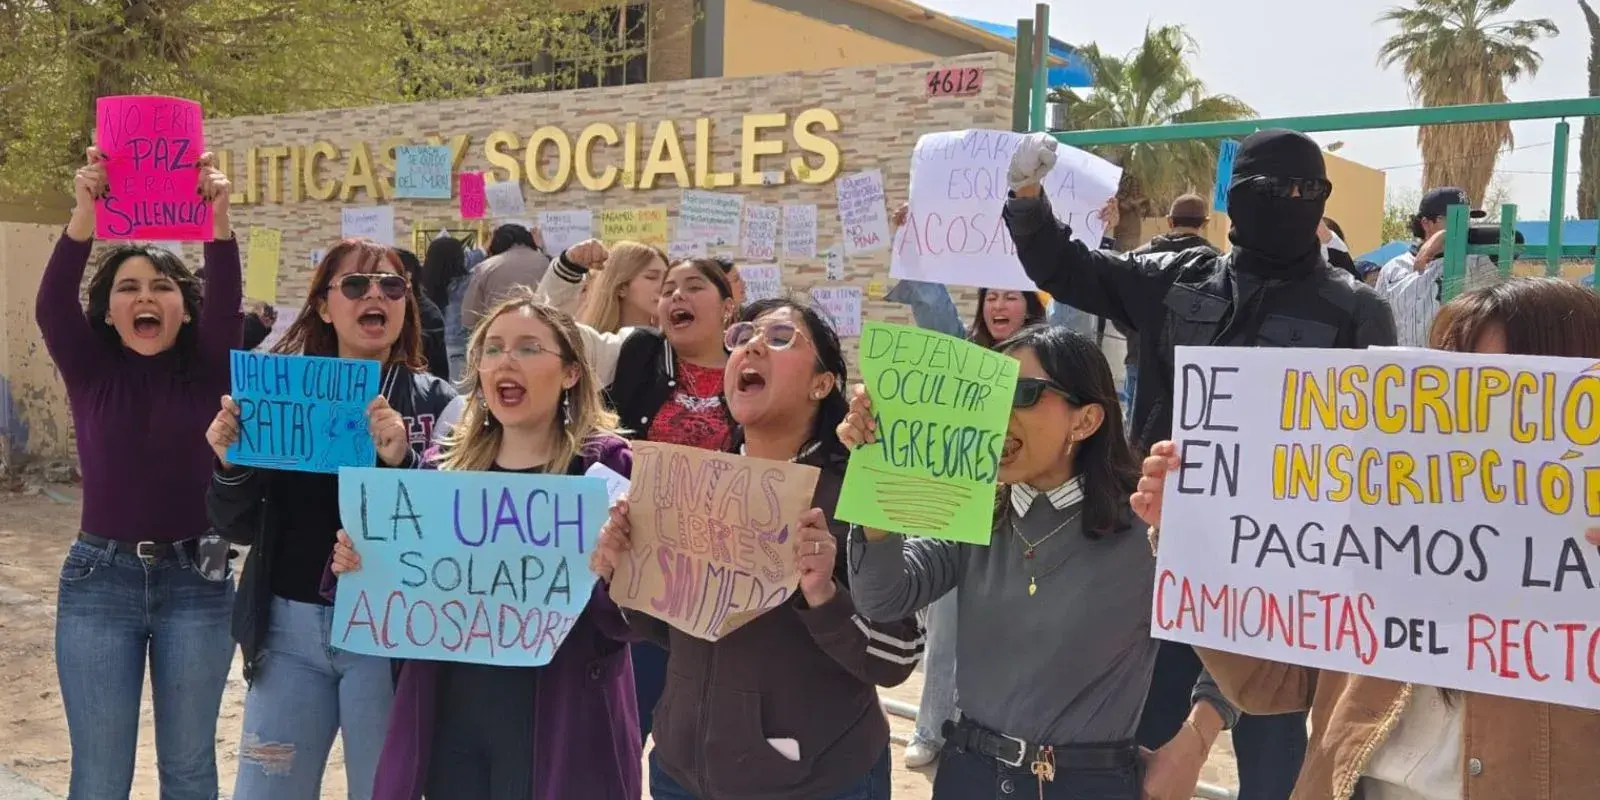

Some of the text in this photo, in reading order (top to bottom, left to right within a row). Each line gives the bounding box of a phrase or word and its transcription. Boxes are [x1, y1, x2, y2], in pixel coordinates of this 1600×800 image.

[929, 68, 979, 94] 4612
[104, 100, 194, 148] NO ERA
[918, 130, 1021, 161] CAMAR
[126, 137, 192, 171] PAZ
[219, 136, 404, 203] LITICAS
[485, 107, 839, 192] SOCIALES
[947, 166, 1076, 201] ESQUA
[124, 175, 174, 194] ERA
[103, 196, 207, 235] SILENCIO
[233, 352, 369, 402] UACH OCULTA
[865, 328, 1013, 390] DEJEN DE
[877, 368, 992, 411] OCULTAR
[1179, 363, 1240, 432] DE
[236, 398, 316, 463] RATAS
[857, 411, 1002, 484] AGRESORES
[629, 446, 785, 528] JUNTAS
[1177, 440, 1240, 497] EN
[360, 478, 585, 555] LA UACH
[655, 508, 784, 585] LIBRES
[1230, 515, 1600, 592] PAGAMOS LA
[399, 550, 571, 606] SOLAPA
[625, 544, 653, 600] Y
[651, 545, 704, 622] SIN
[1156, 569, 1379, 665] CAMIONETAS
[1385, 616, 1449, 655] DEL
